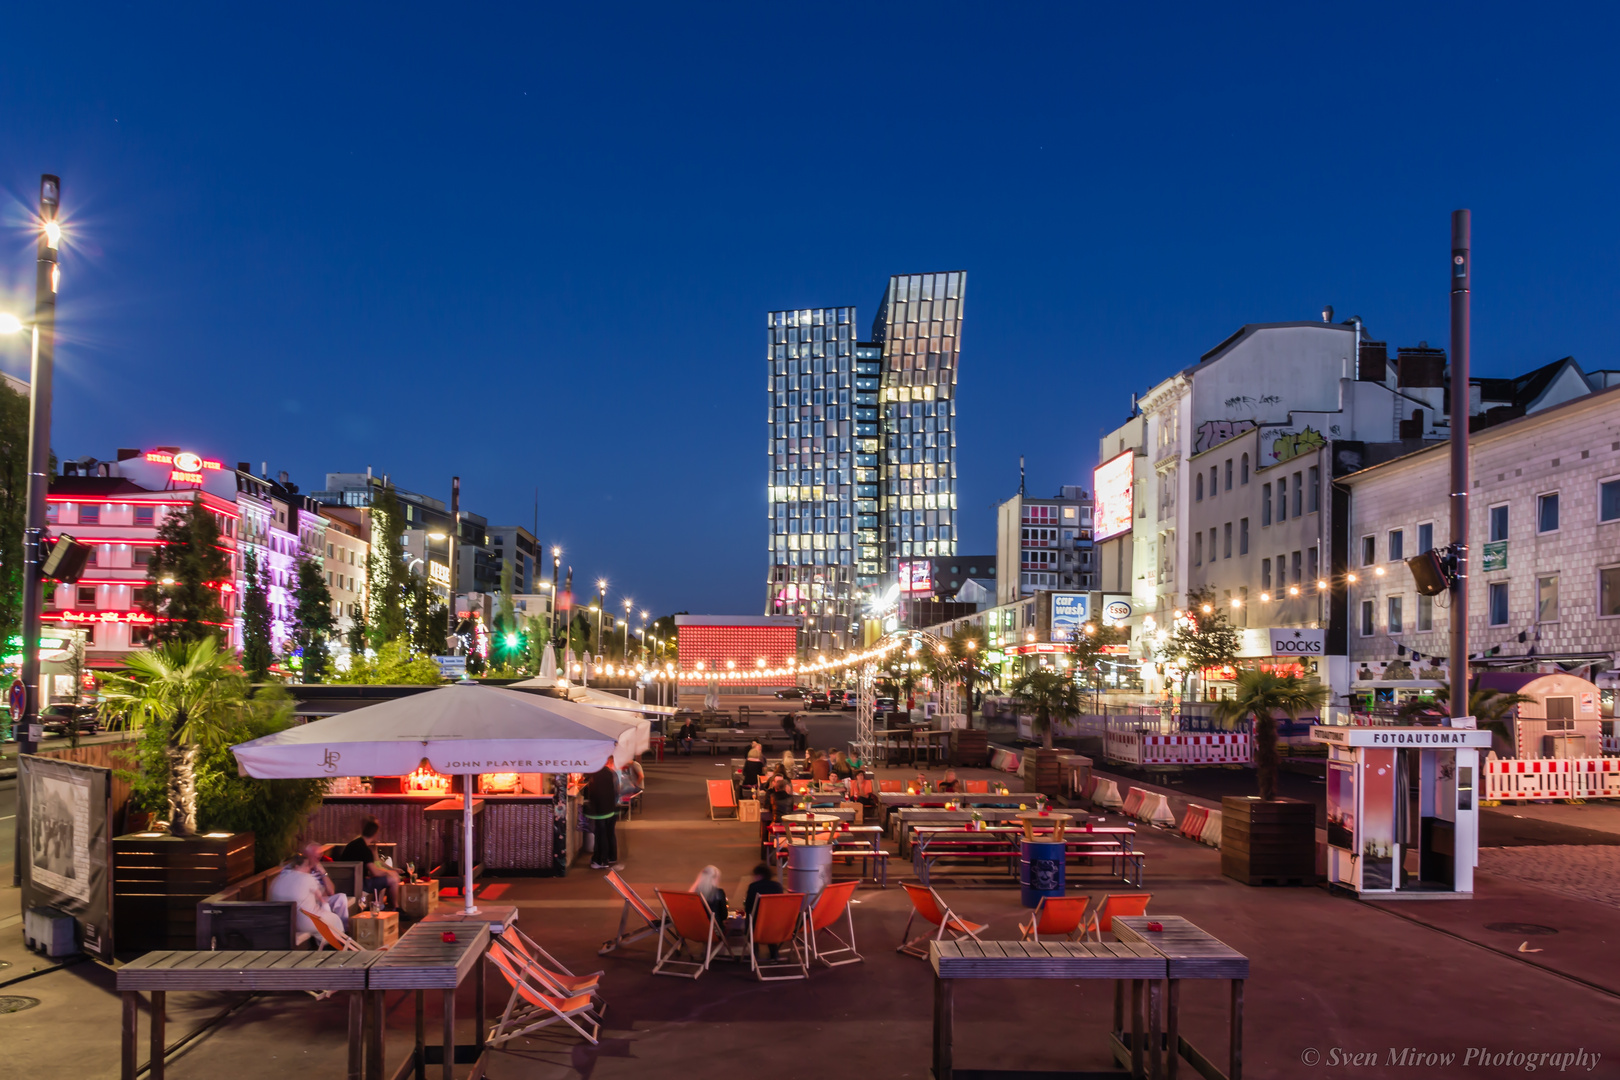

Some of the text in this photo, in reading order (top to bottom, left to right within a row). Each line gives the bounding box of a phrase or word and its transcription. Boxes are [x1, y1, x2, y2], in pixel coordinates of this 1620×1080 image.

[147, 453, 172, 464] STEAK
[172, 470, 203, 484] HOUSE
[1056, 597, 1073, 605] car
[1056, 603, 1085, 615] wash
[1110, 606, 1128, 614] Esso
[1276, 640, 1321, 652] DOCKS
[1314, 729, 1345, 742] FOTOAUTOMAT
[1373, 733, 1467, 744] FOTOAUTOMAT
[537, 759, 590, 767] SPECIAL
